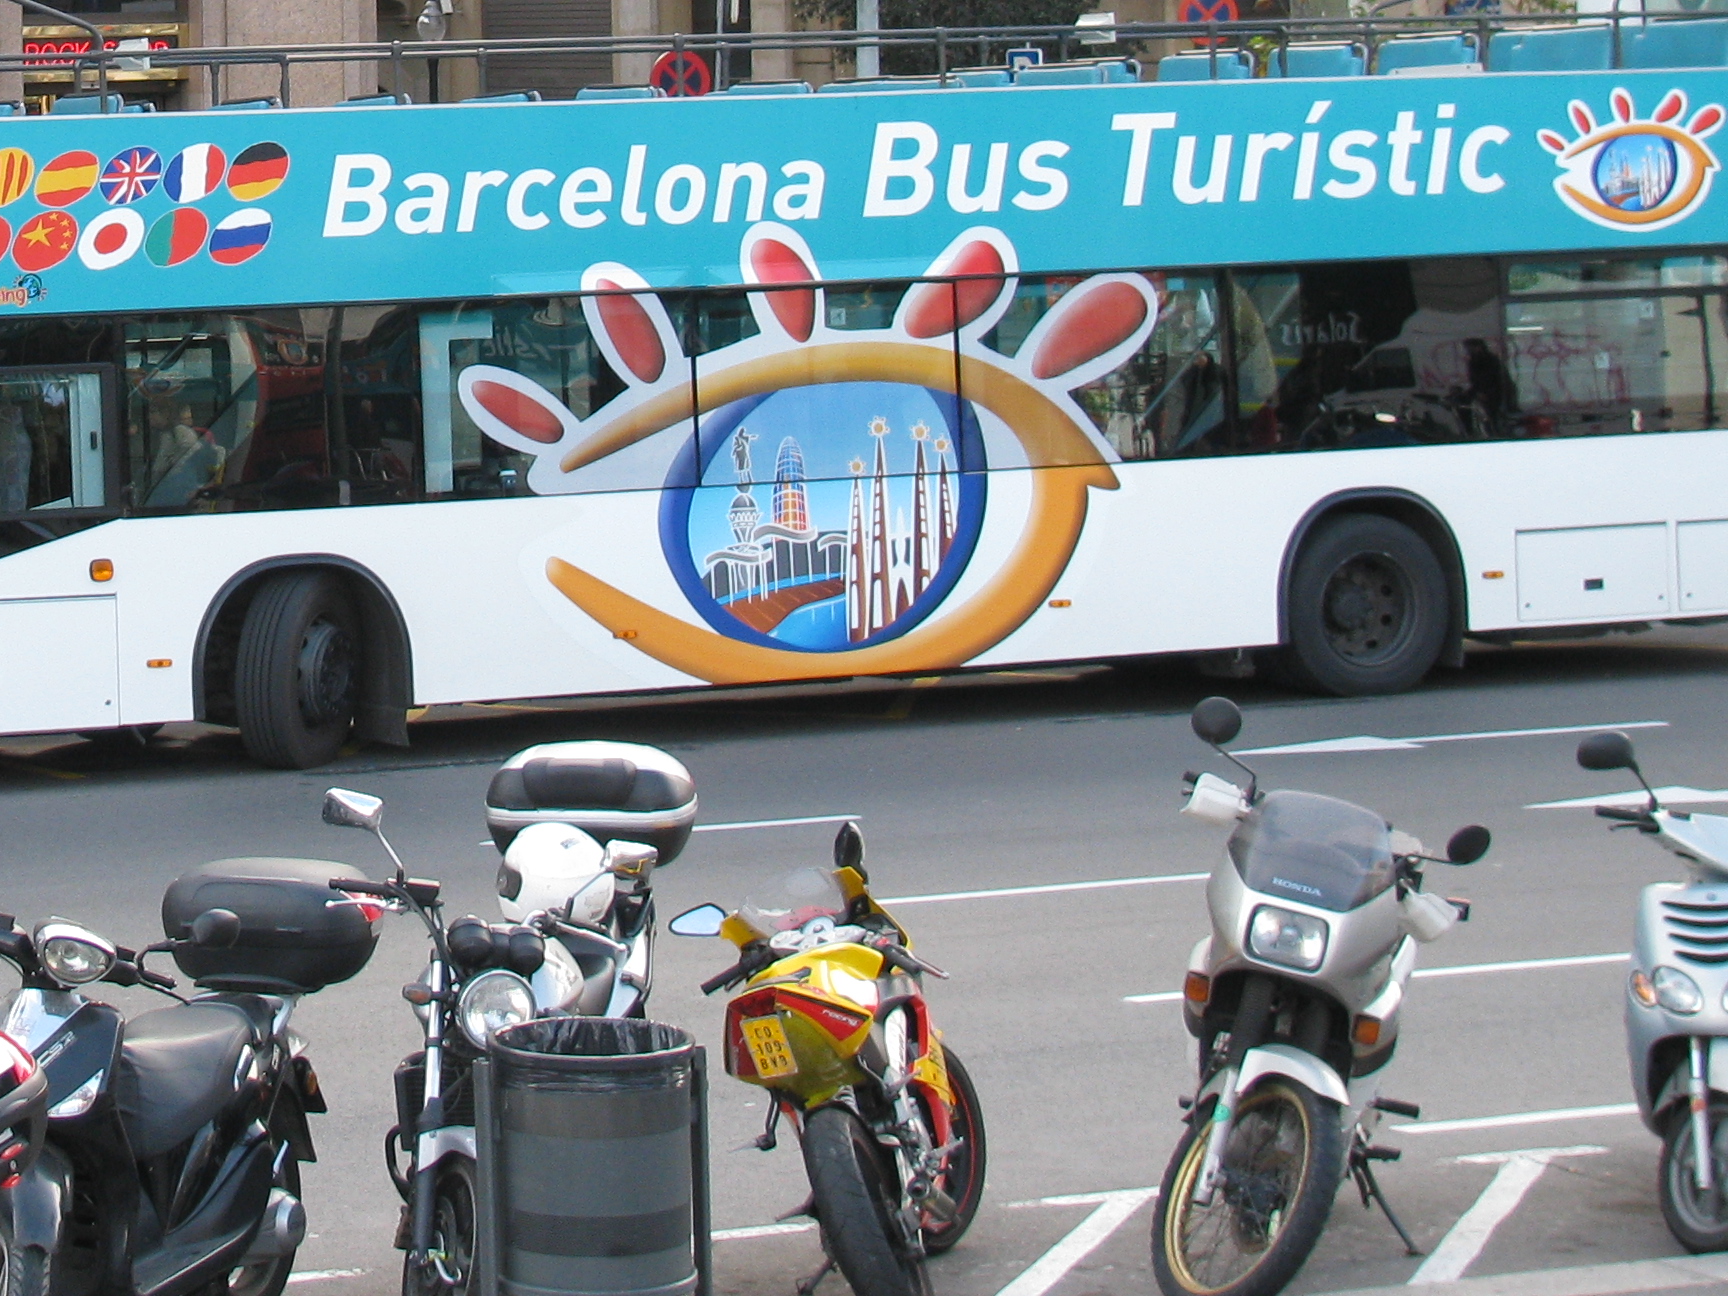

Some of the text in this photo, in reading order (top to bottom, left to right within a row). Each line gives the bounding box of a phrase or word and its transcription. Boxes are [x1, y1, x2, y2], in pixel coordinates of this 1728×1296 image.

[322, 101, 1511, 238] Barcelona Bus Turístic
[1272, 877, 1322, 897] HONDA
